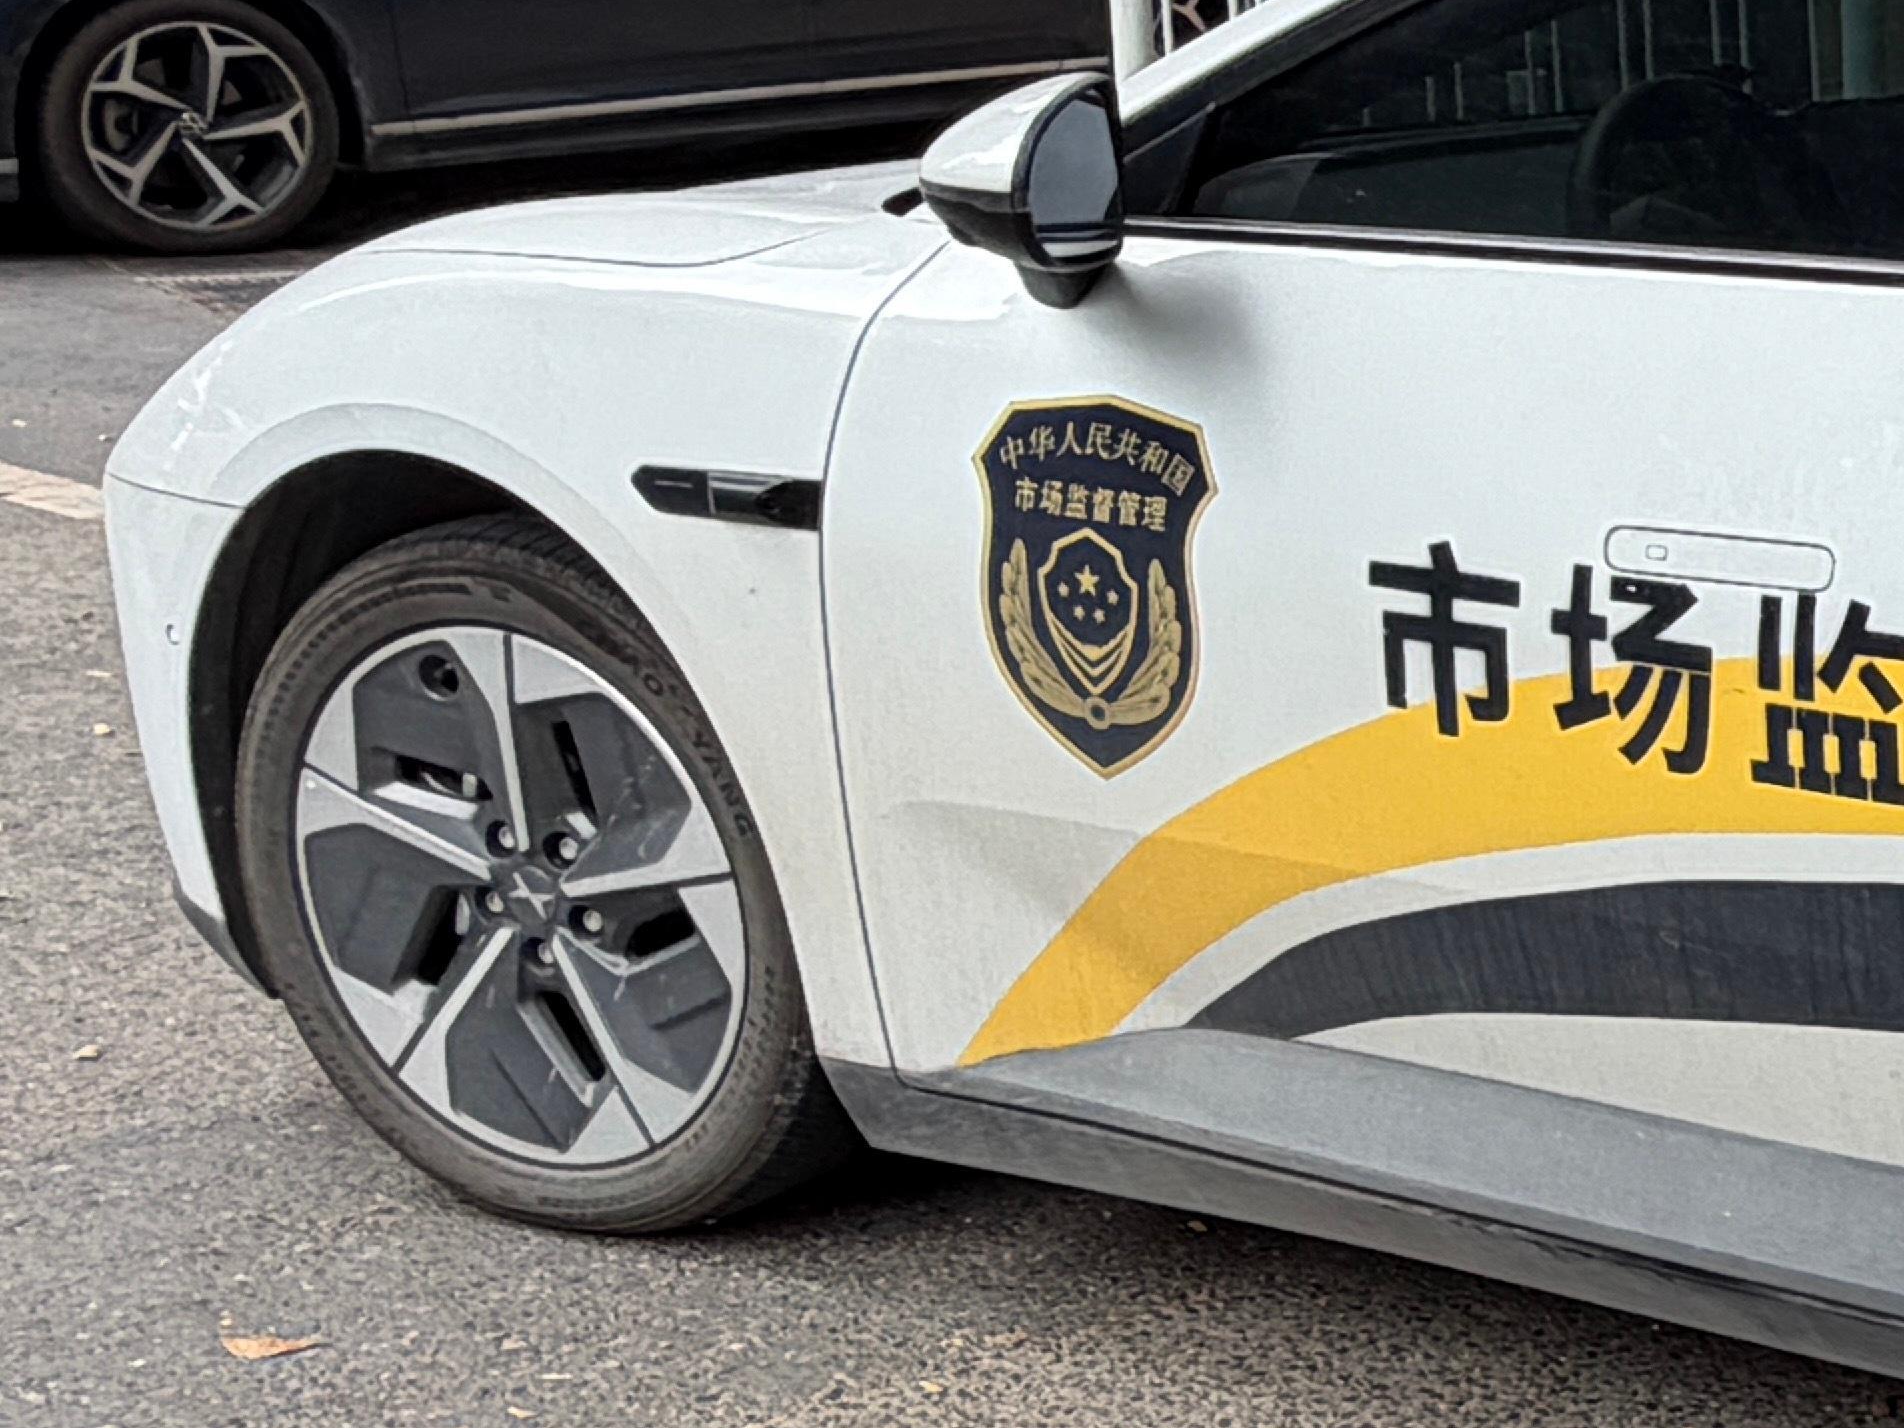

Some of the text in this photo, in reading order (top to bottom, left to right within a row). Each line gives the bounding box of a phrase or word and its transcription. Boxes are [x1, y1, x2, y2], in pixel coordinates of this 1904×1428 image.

[1000, 420, 1195, 496] 中华人民共和国
[1014, 476, 1168, 532] 市场监督管理
